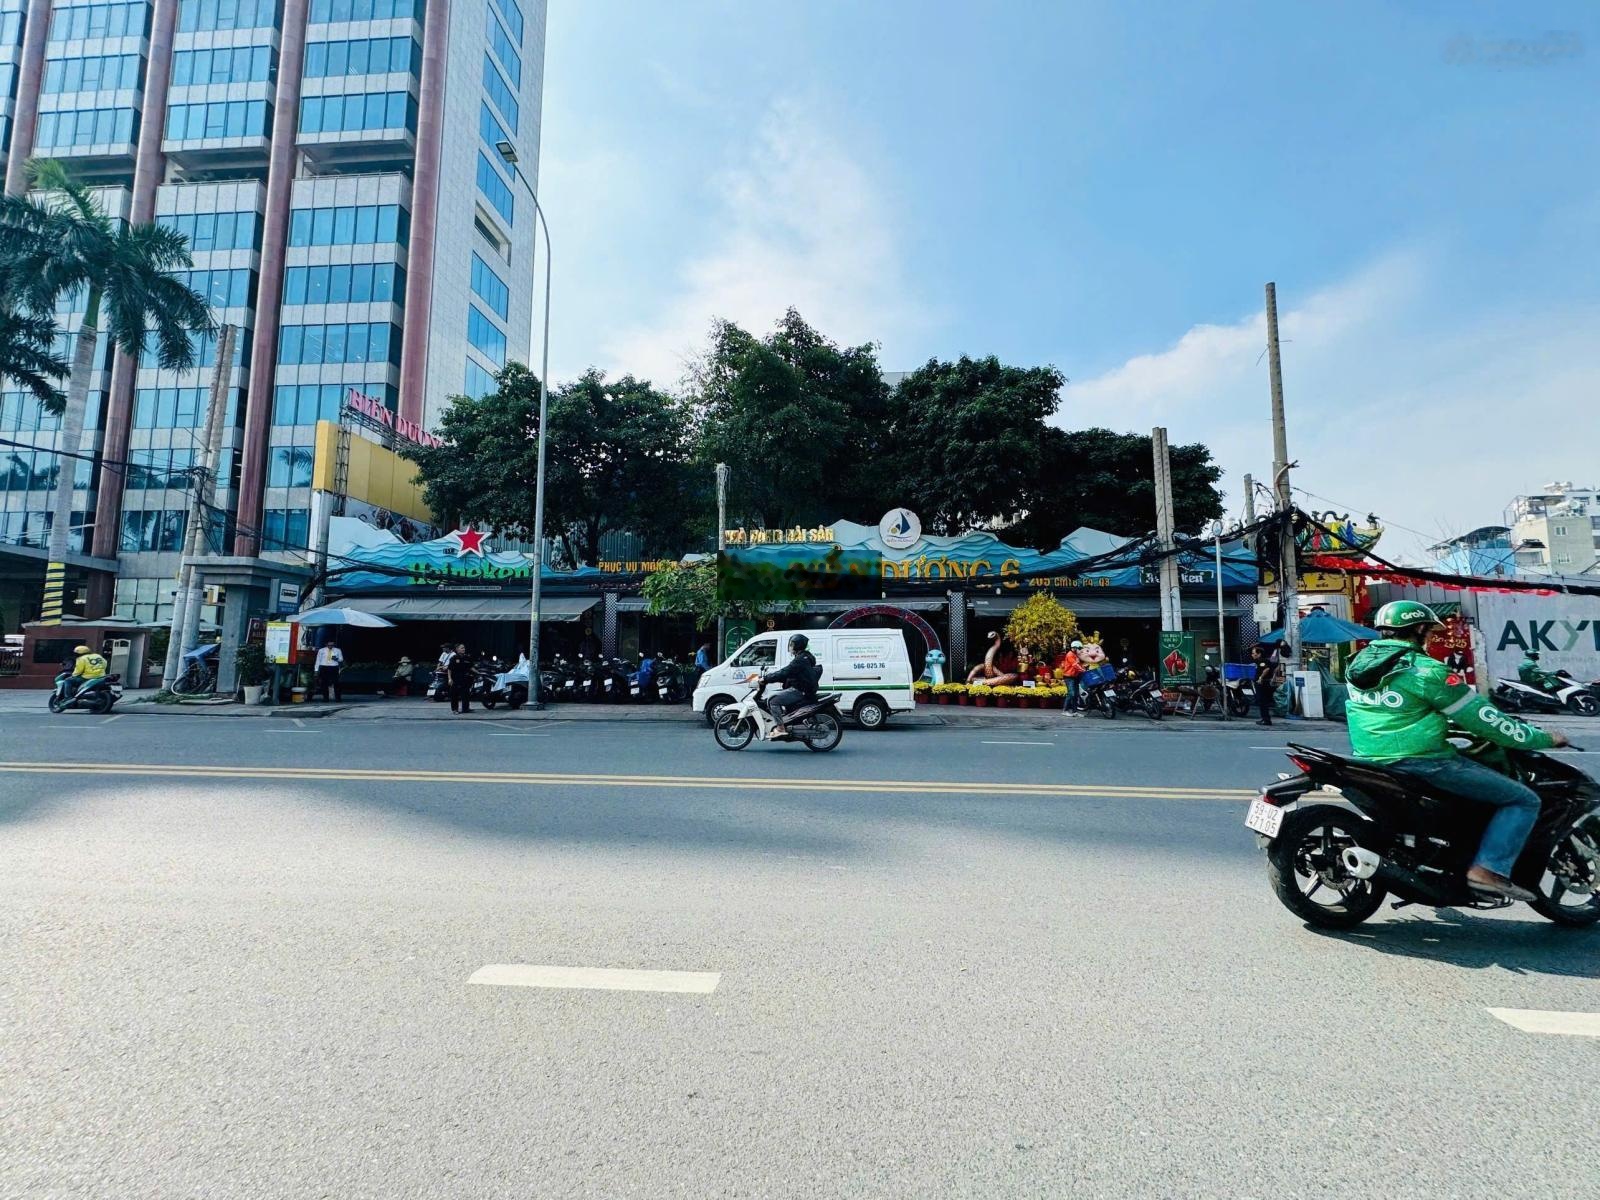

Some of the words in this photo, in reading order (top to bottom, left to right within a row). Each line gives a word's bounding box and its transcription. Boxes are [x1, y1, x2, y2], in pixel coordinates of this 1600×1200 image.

[598, 561, 622, 573] PHỤC
[1401, 610, 1425, 620] Grab
[1497, 620, 1600, 651] AKY
[1478, 706, 1527, 743] Grab
